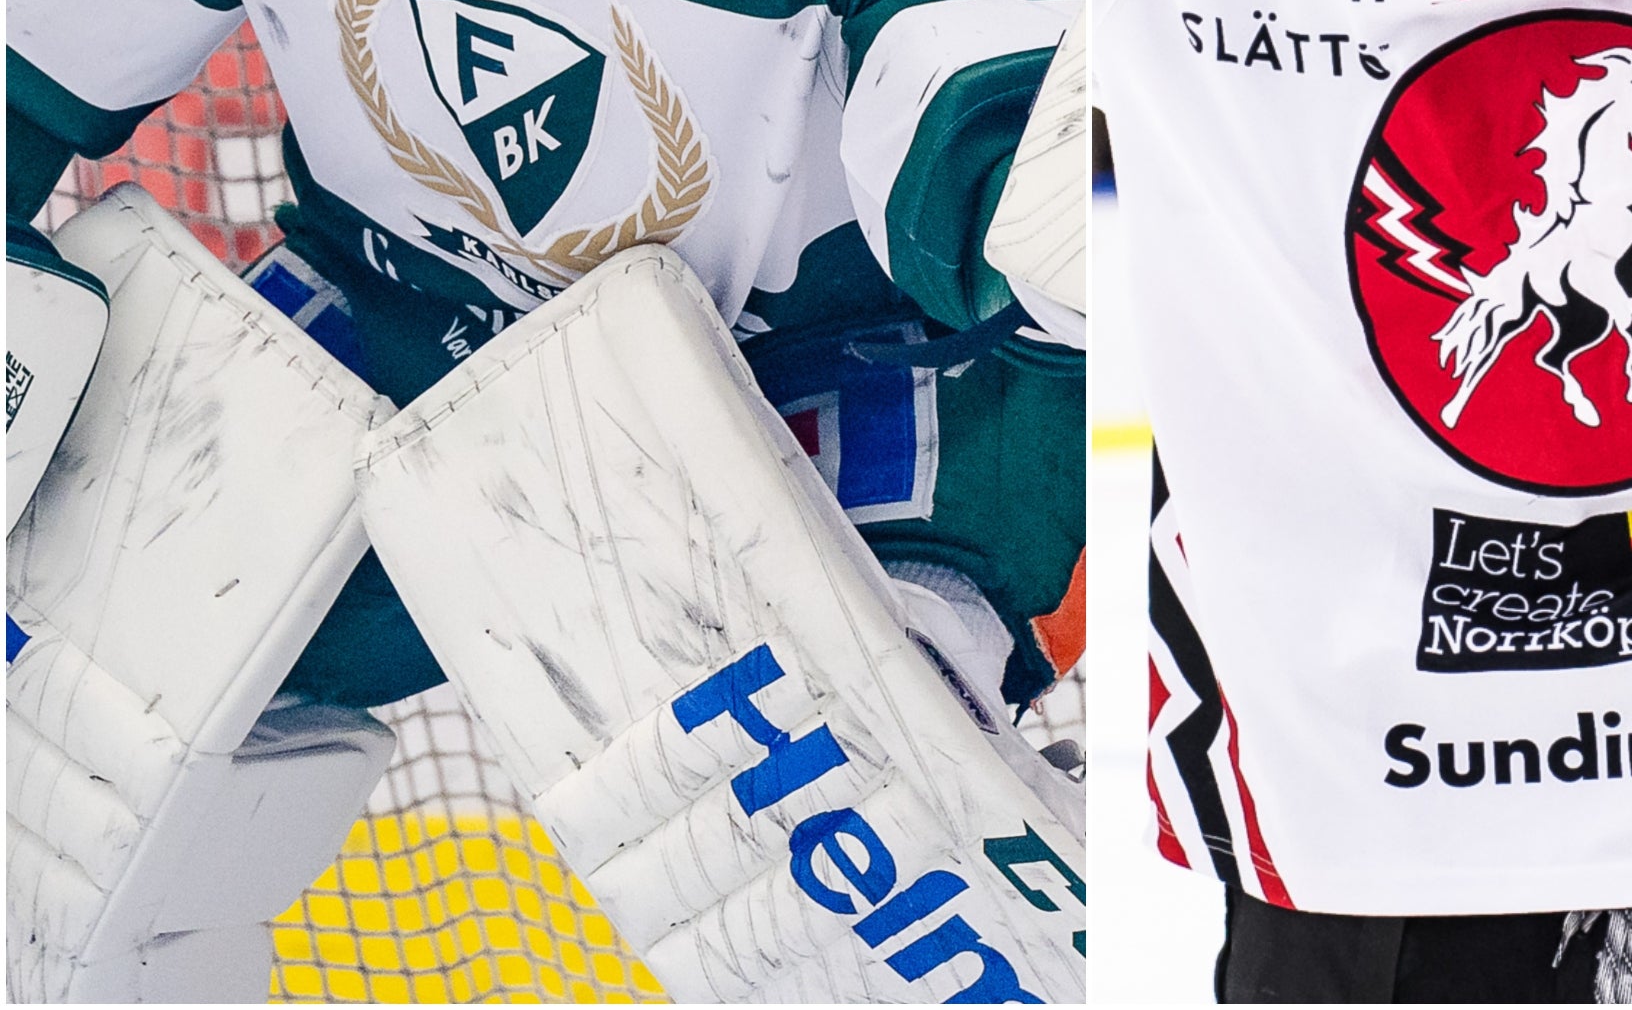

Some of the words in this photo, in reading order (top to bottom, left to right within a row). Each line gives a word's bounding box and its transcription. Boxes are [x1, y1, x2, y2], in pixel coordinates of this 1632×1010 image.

[455, 11, 515, 106] F
[1180, 9, 1391, 81] SLÄTTÖ
[493, 94, 562, 181] BK
[462, 235, 564, 300] KARLS
[1440, 518, 1565, 581] Let's
[1432, 583, 1614, 622] create
